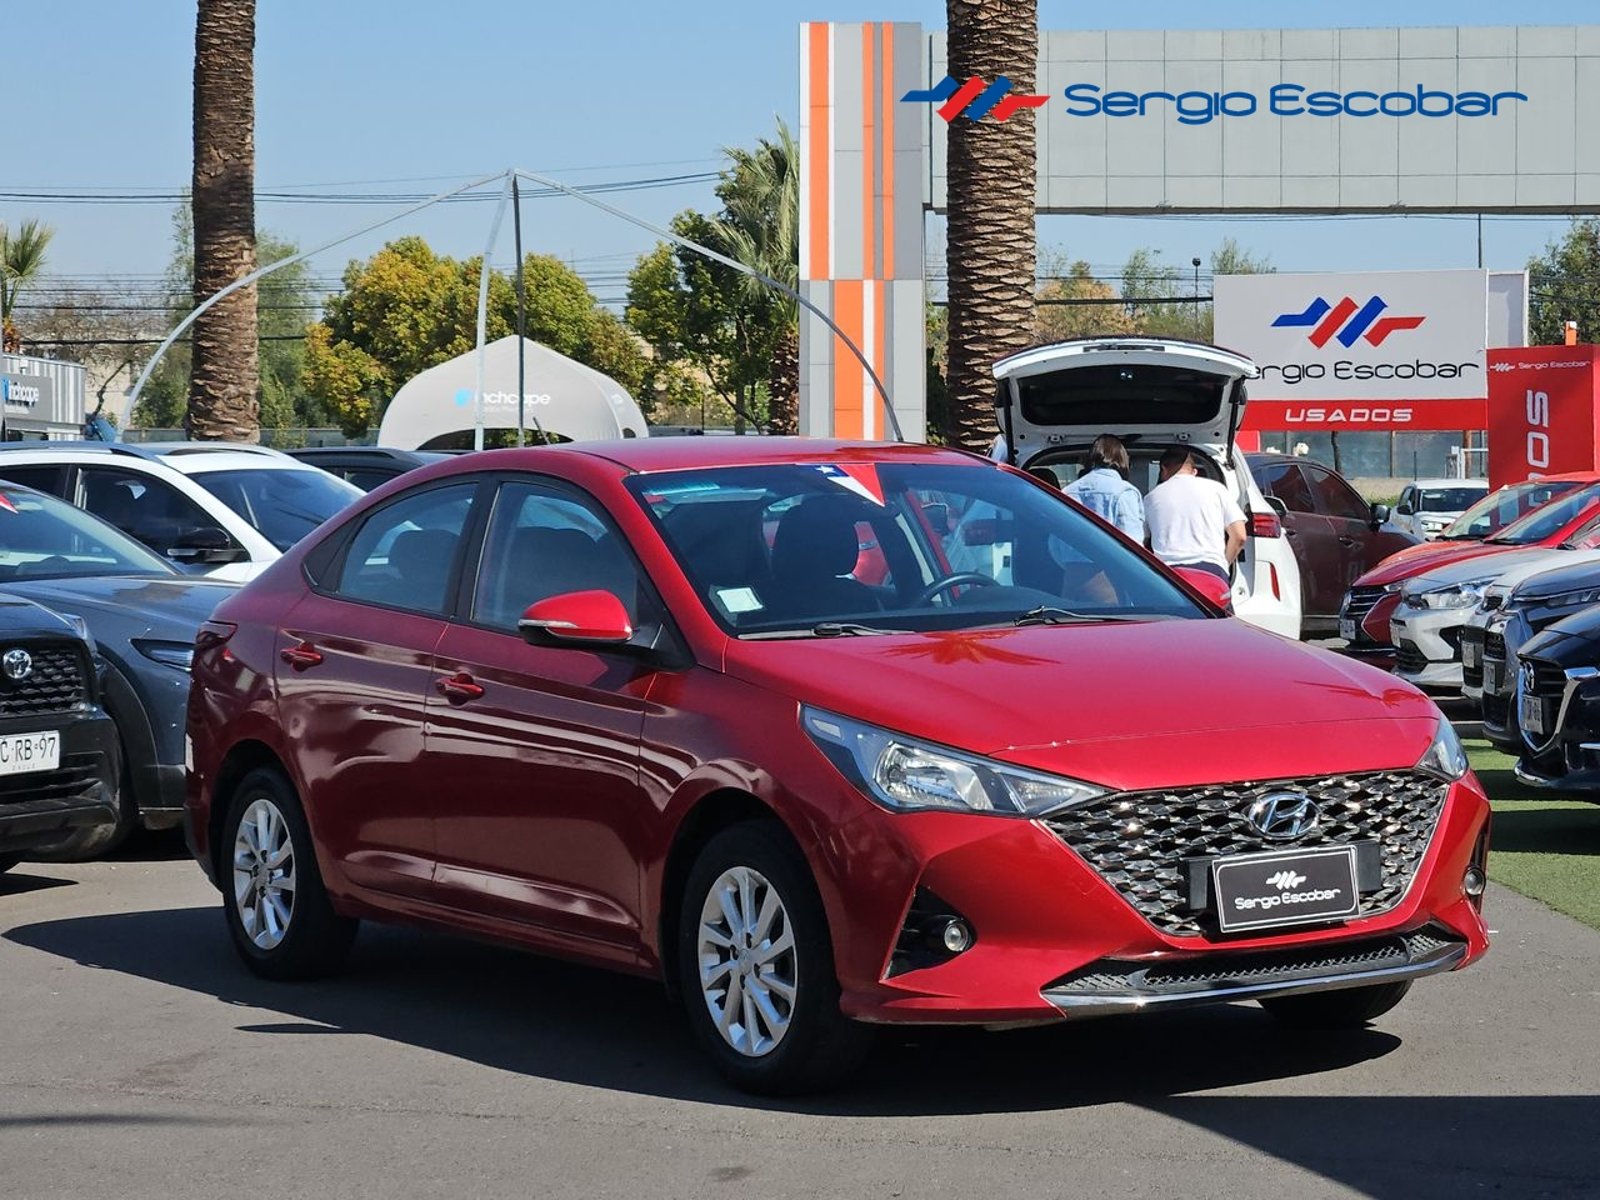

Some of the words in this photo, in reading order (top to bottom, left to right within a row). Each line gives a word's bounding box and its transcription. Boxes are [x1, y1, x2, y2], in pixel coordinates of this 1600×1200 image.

[1245, 363, 1326, 385] ergio
[1333, 359, 1480, 381] Escobar
[1549, 360, 1591, 369] Escobar
[1285, 408, 1414, 422] USADOS
[1281, 888, 1342, 904] Escobar
